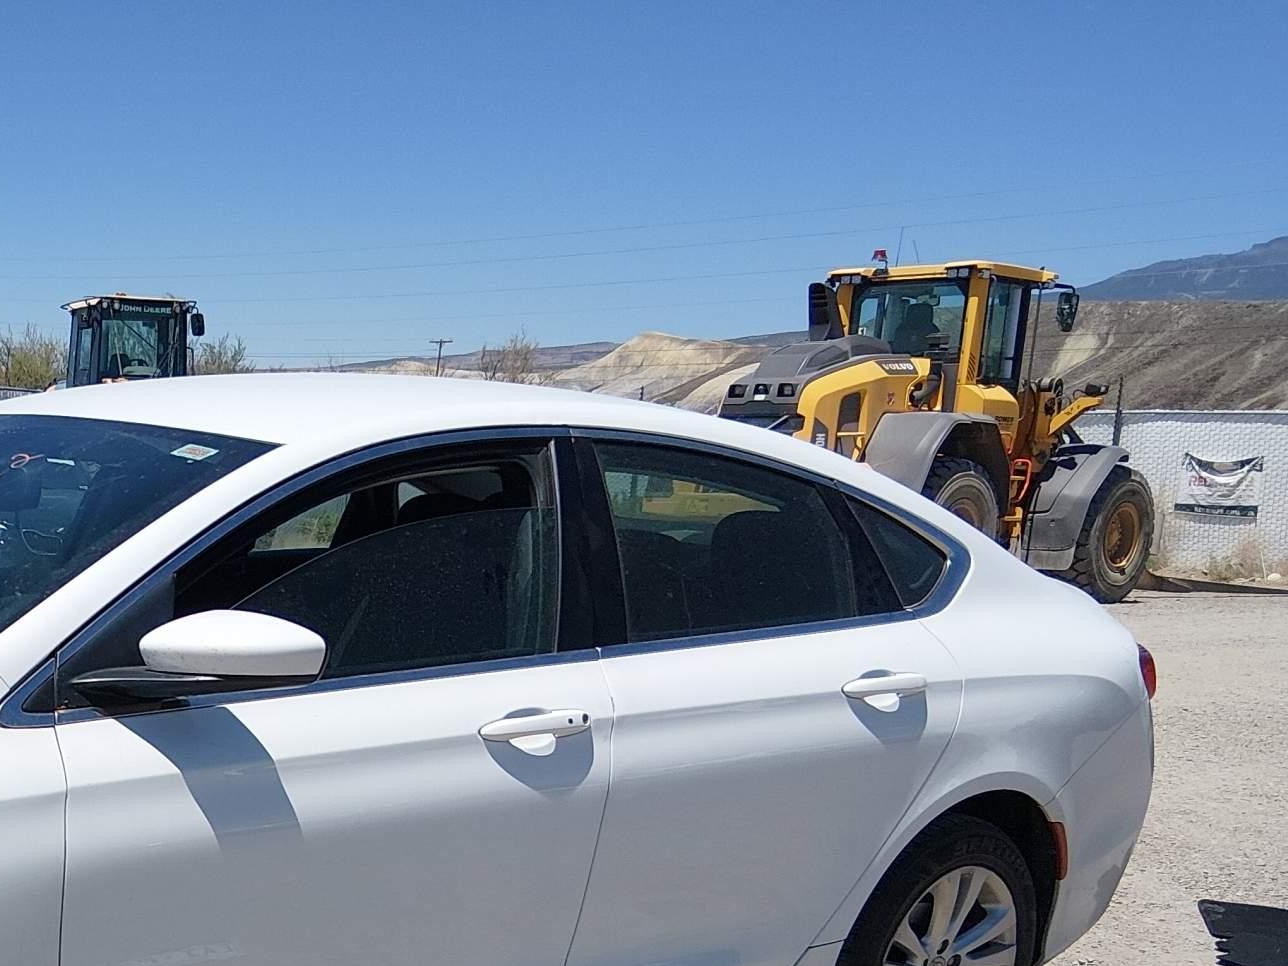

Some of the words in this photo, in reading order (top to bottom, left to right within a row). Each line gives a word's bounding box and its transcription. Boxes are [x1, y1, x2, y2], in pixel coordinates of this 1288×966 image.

[120, 303, 143, 313] JOHN
[143, 304, 172, 314] DEERE
[881, 363, 914, 371] VOLVO
